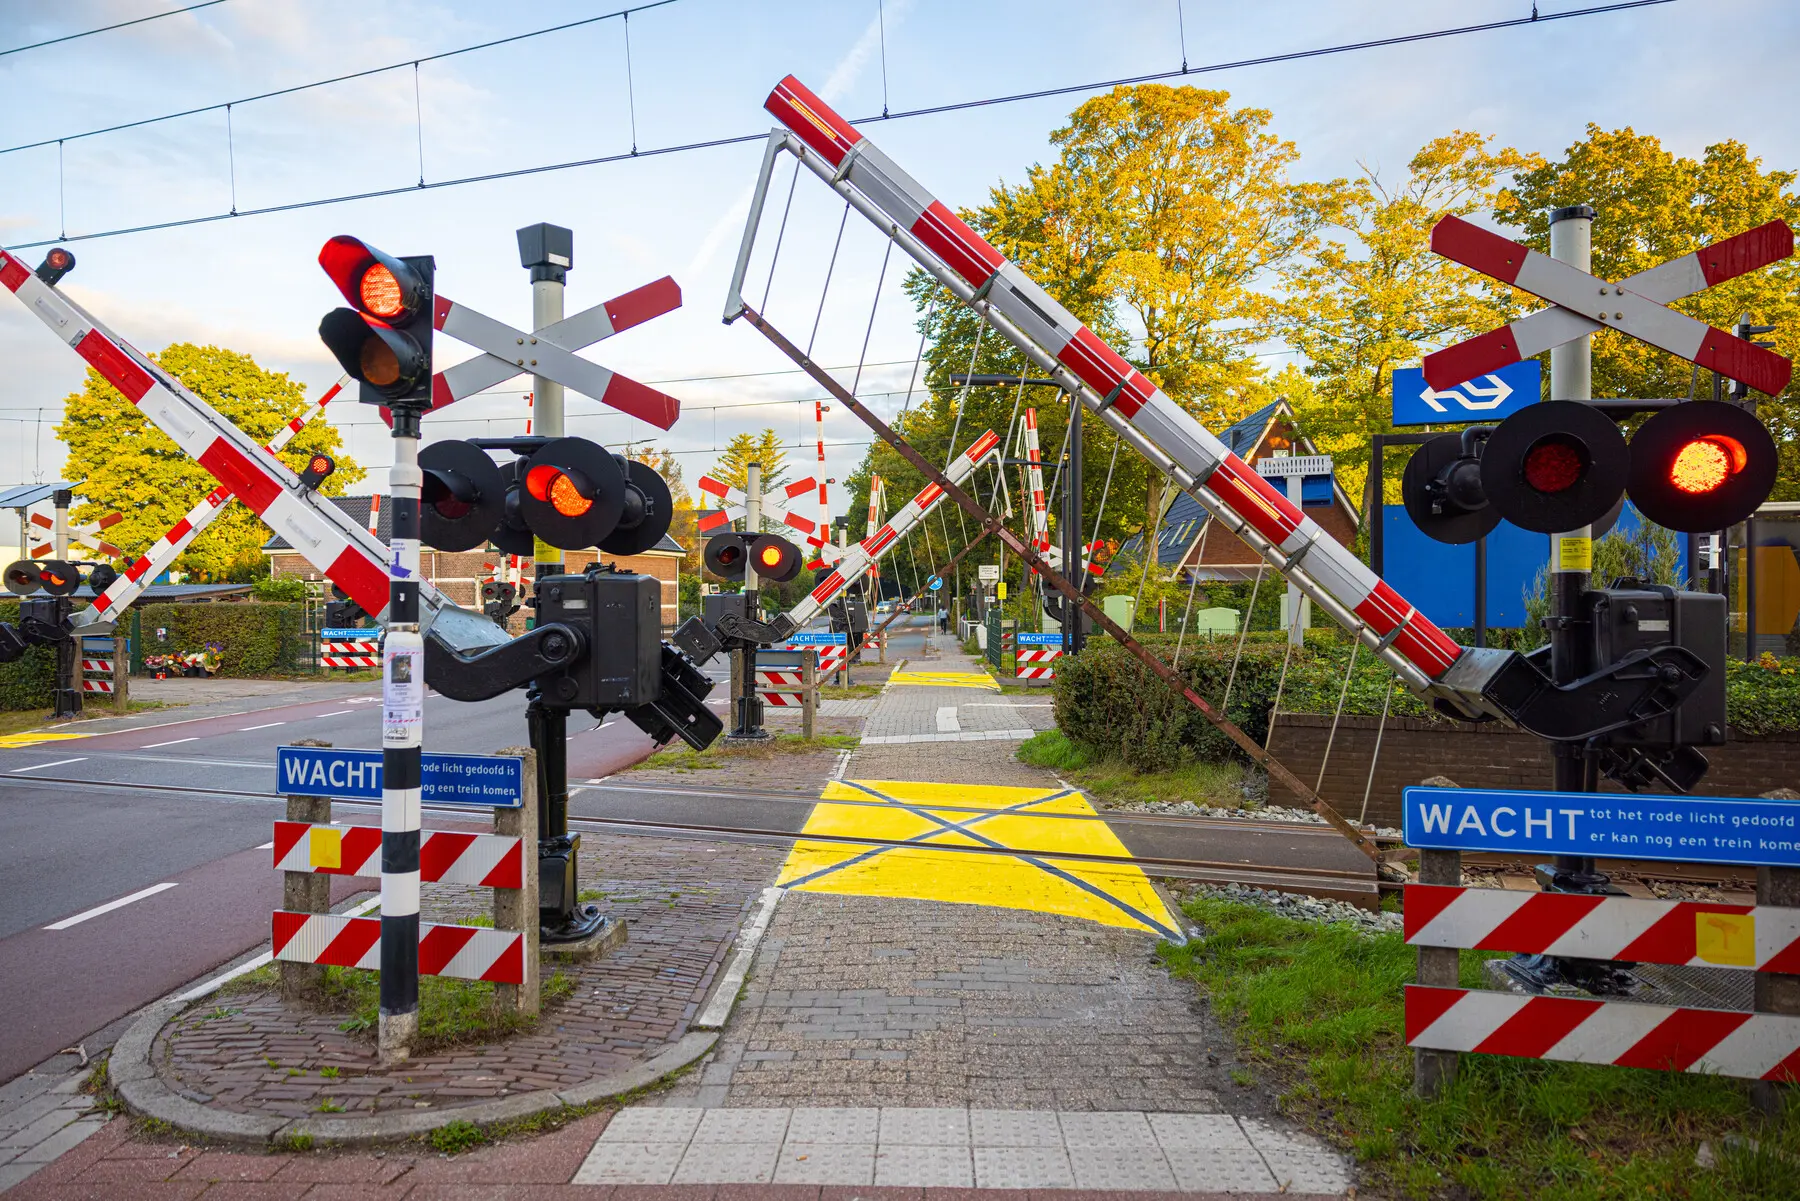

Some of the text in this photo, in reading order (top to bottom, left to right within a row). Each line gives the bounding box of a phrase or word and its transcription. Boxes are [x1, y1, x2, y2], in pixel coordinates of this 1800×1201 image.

[284, 757, 383, 789] WACHT
[421, 763, 515, 776] ode licht gedoofd is
[438, 785, 455, 793] een
[457, 784, 480, 794] trein
[1419, 803, 1585, 841] WACHT
[1590, 808, 1795, 828] tot het rode licht gedoofd
[1590, 832, 1606, 842] er
[1612, 832, 1638, 844] kan
[1646, 835, 1673, 848] nog
[1680, 837, 1707, 847] een
[1714, 836, 1752, 849] trein
